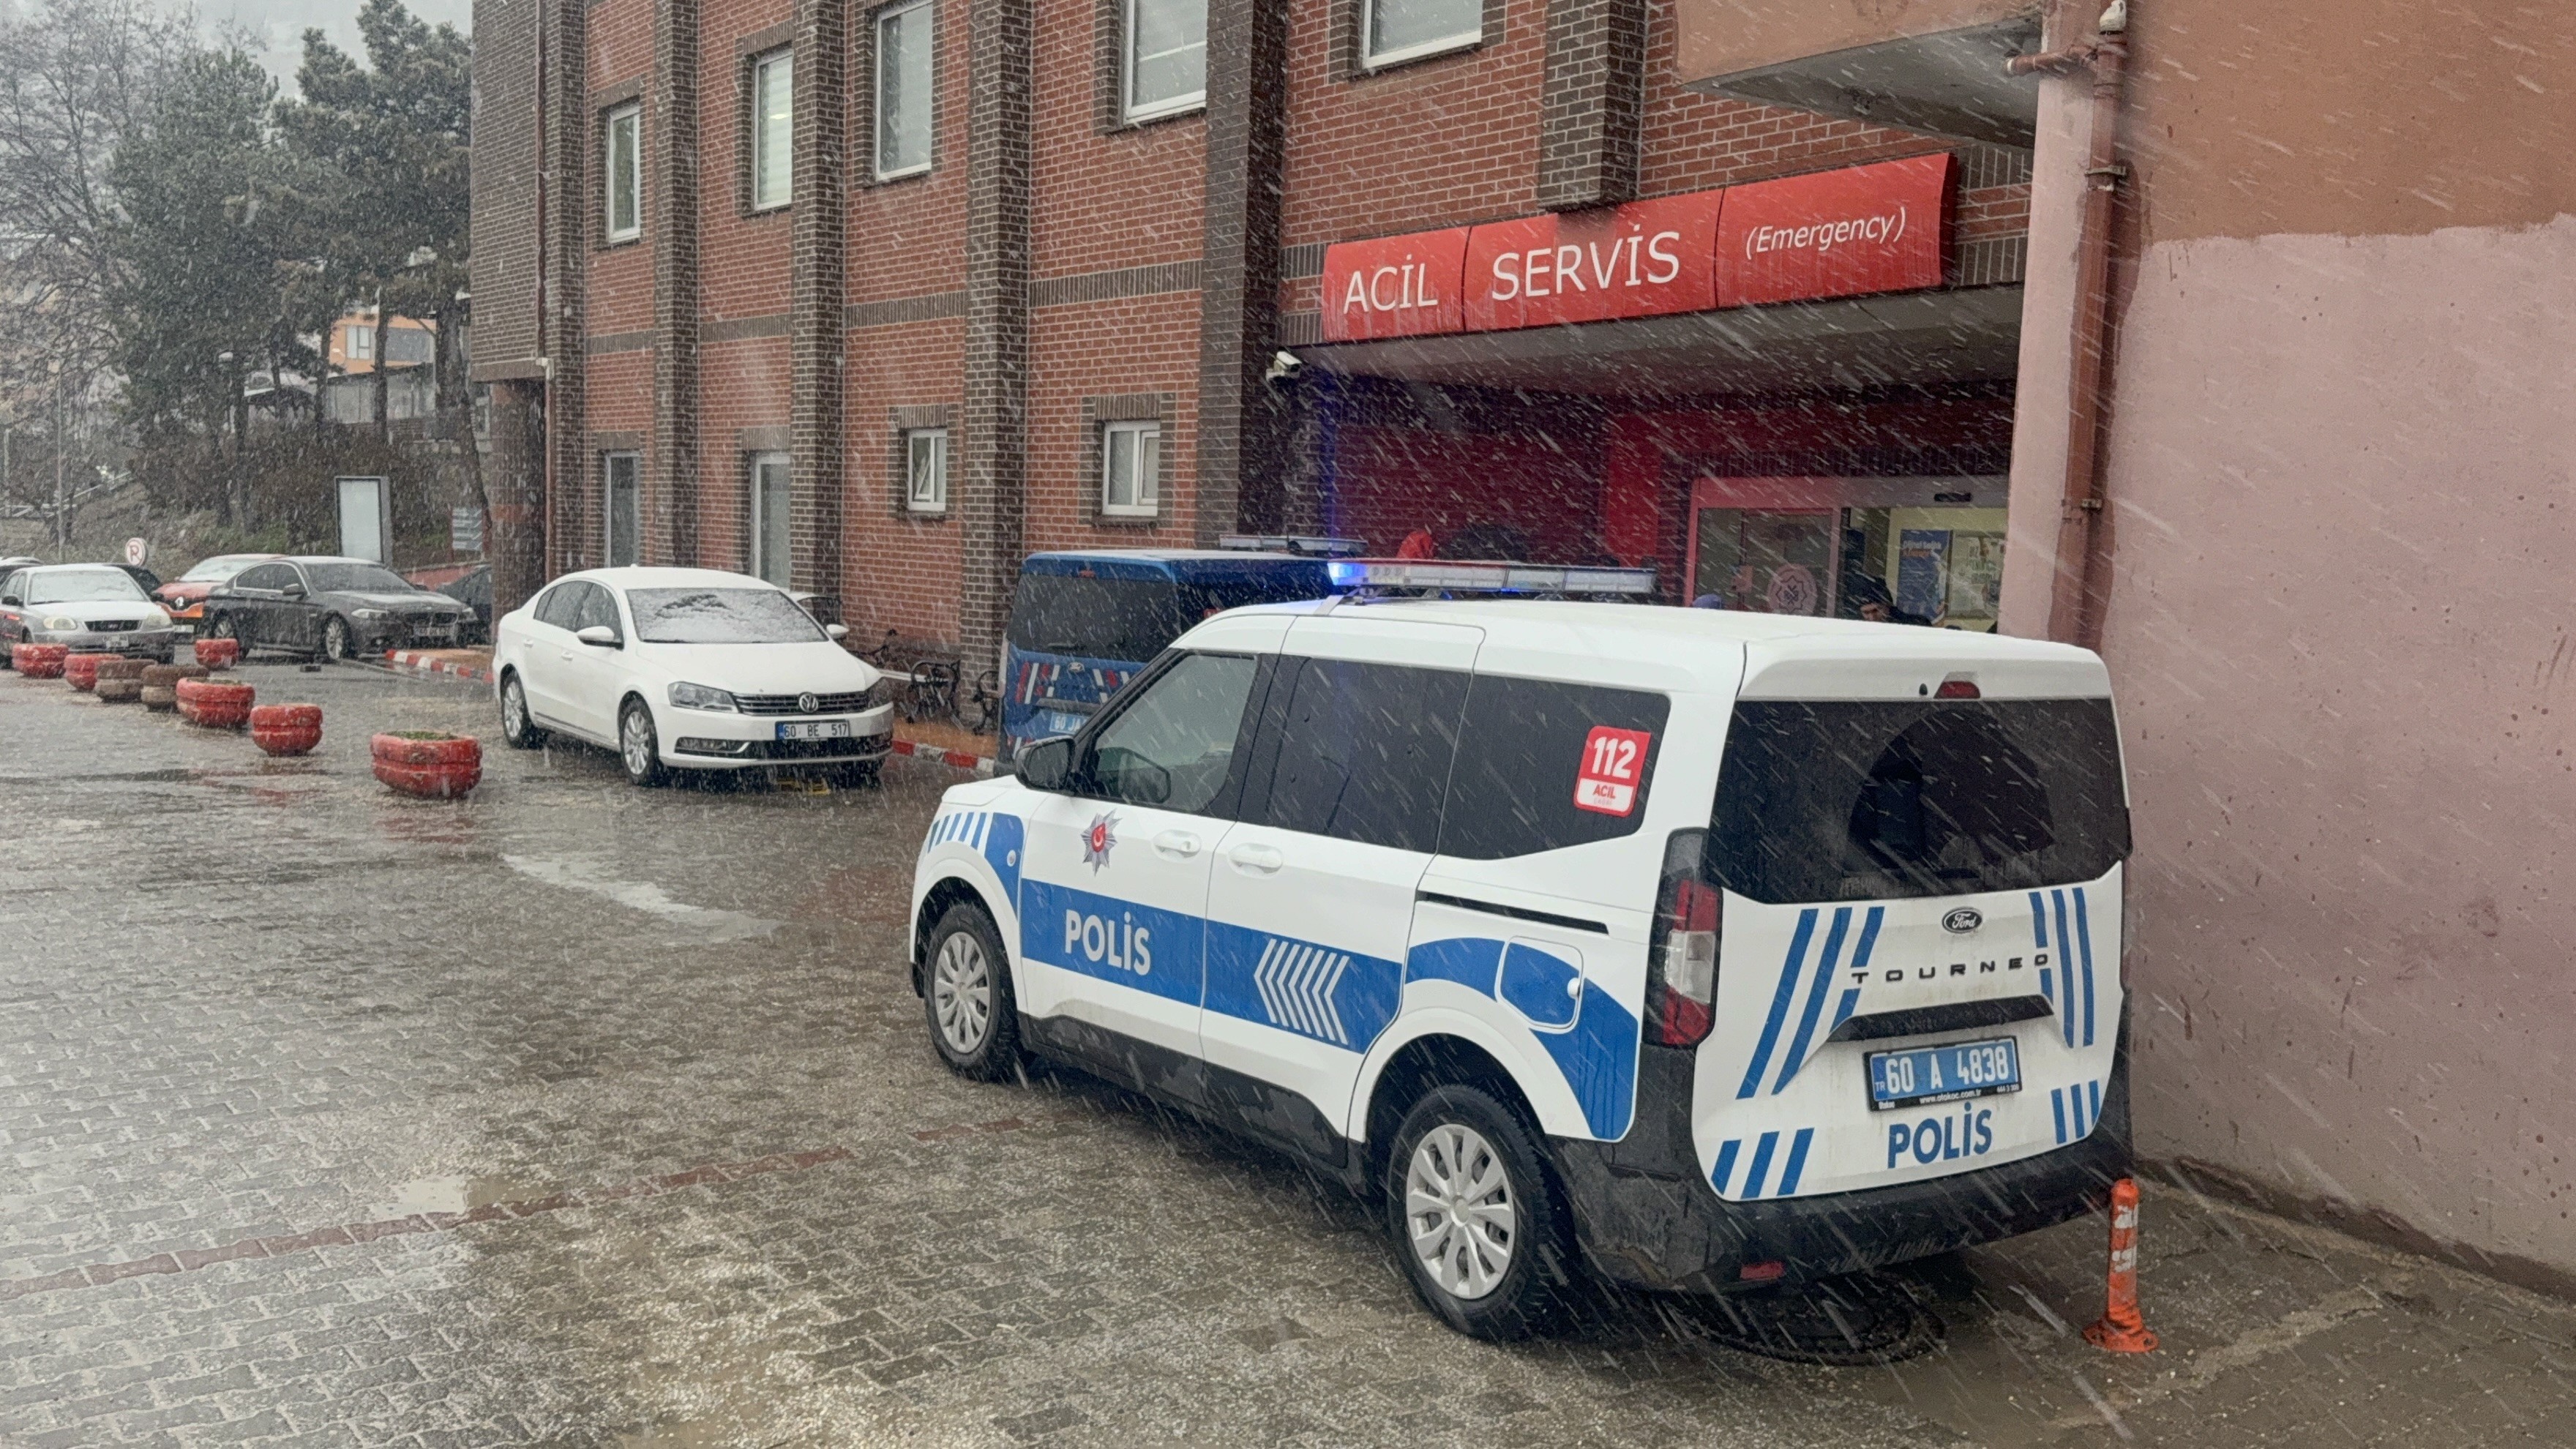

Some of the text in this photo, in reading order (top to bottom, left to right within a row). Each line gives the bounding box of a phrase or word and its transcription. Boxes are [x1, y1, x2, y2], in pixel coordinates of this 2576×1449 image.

[1745, 206, 1906, 261] (Emergency)
[1343, 225, 1681, 313] ACİL SERVİS
[784, 723, 847, 738] 60 BE 517
[1591, 735, 1637, 779] 112
[1064, 910, 1151, 976] POLİS
[1951, 913, 1977, 929] Ford
[1851, 954, 2048, 984] TOURNEO
[1874, 1081, 1886, 1092] TR
[1885, 1045, 2009, 1094] 60 A 4838
[1887, 1101, 1993, 1169] POLİS
